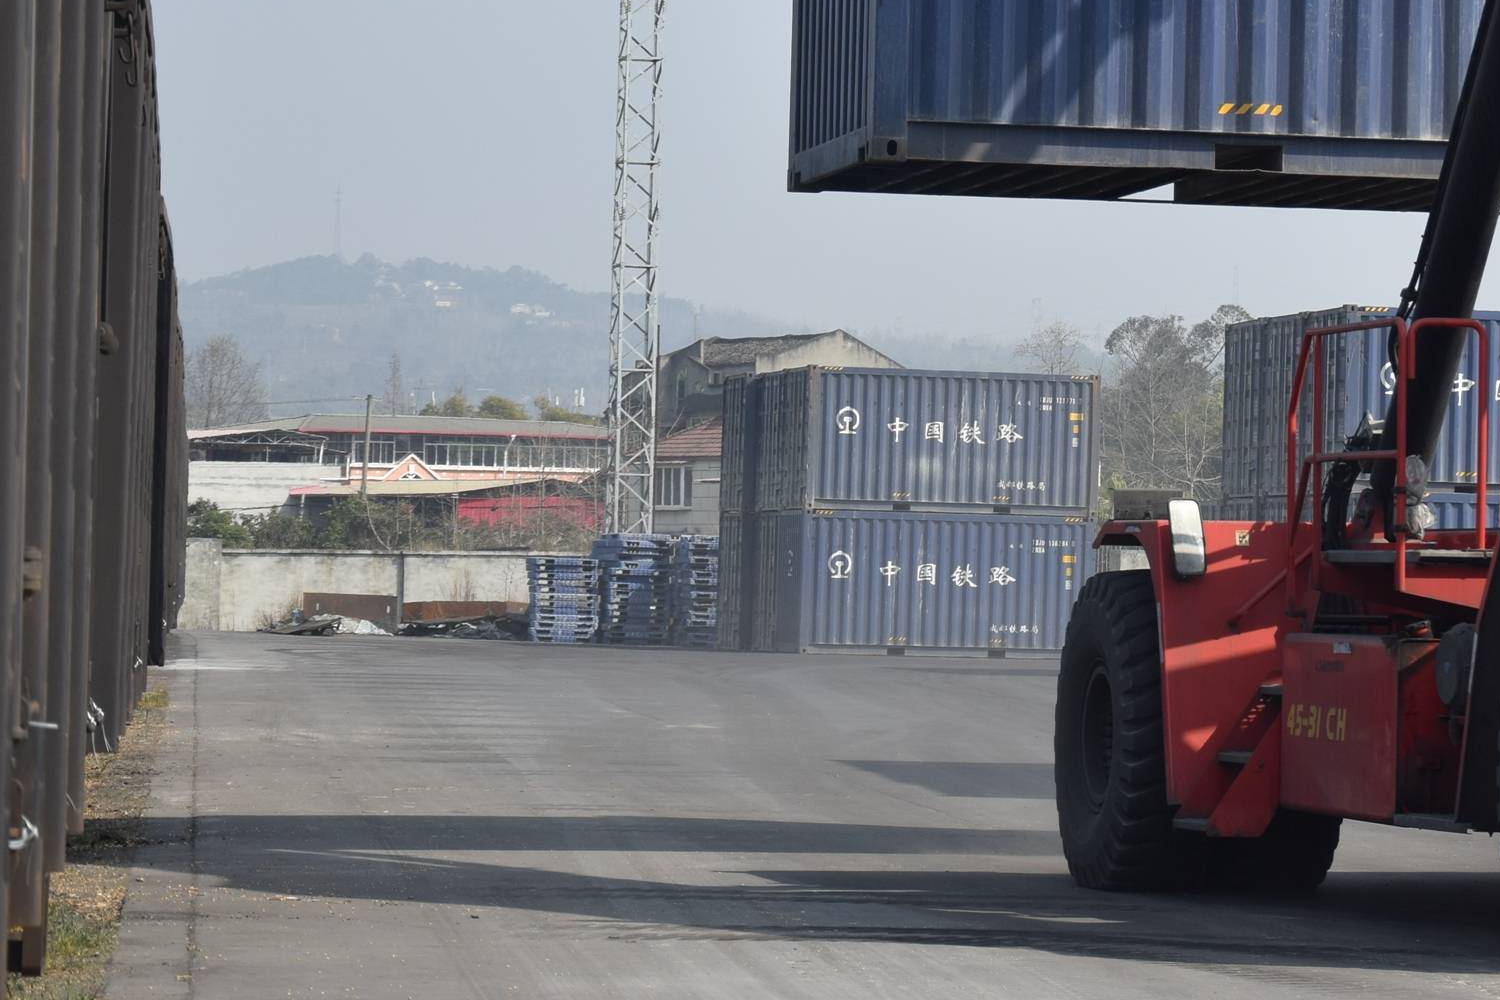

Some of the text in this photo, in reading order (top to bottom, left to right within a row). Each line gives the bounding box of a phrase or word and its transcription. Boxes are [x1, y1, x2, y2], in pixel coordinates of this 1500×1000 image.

[887, 416, 1024, 445] 中国铁路
[879, 560, 1016, 588] 中国铁路
[1326, 707, 1347, 742] CH
